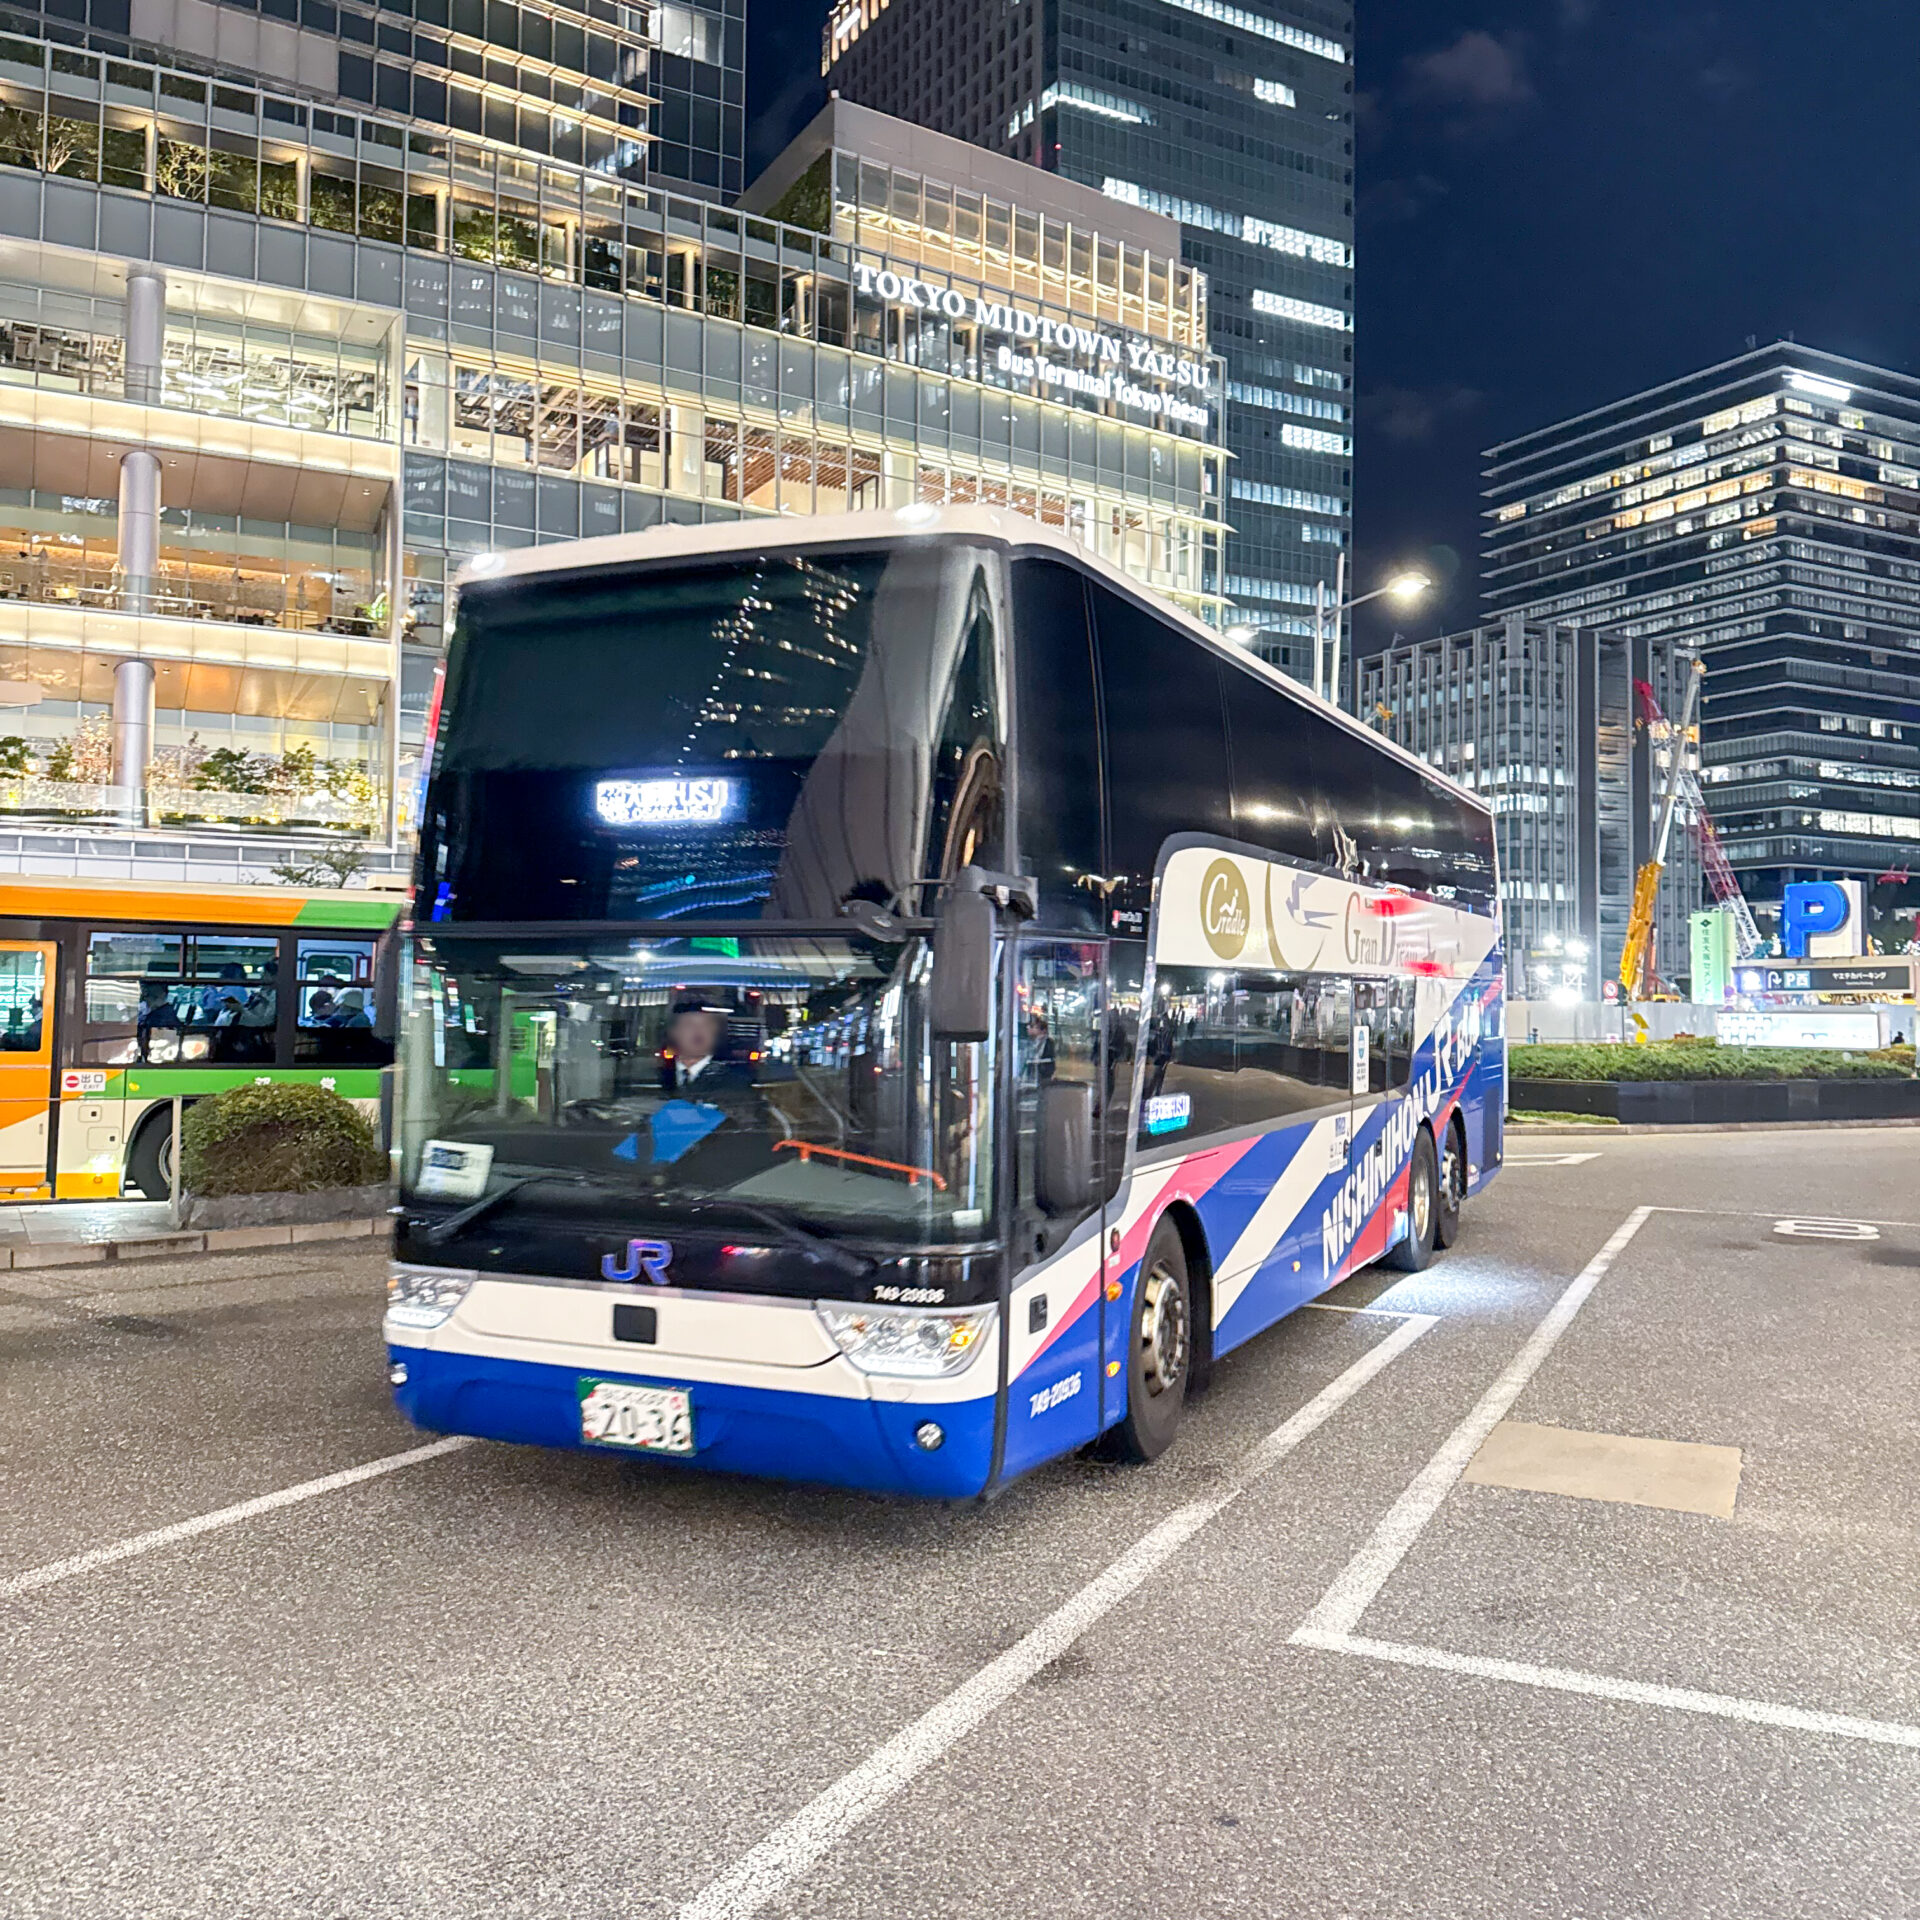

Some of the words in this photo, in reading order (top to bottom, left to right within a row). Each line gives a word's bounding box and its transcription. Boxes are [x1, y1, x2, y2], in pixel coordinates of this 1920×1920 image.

[853, 262, 966, 317] TOKYO
[973, 298, 1122, 363] MIDTOWN
[1126, 342, 1210, 389] YAESU
[998, 346, 1034, 377] Bus
[1036, 355, 1112, 398] Terminal
[1113, 375, 1162, 412] Tokyo
[1161, 391, 1208, 426] Yaesu
[1206, 873, 1246, 936] Cradle
[1784, 881, 1847, 958] P
[81, 1074, 104, 1084] 出口
[1323, 1075, 1424, 1281] NISHINIHON
[1425, 1010, 1454, 1114] JR
[601, 1239, 673, 1286] JR
